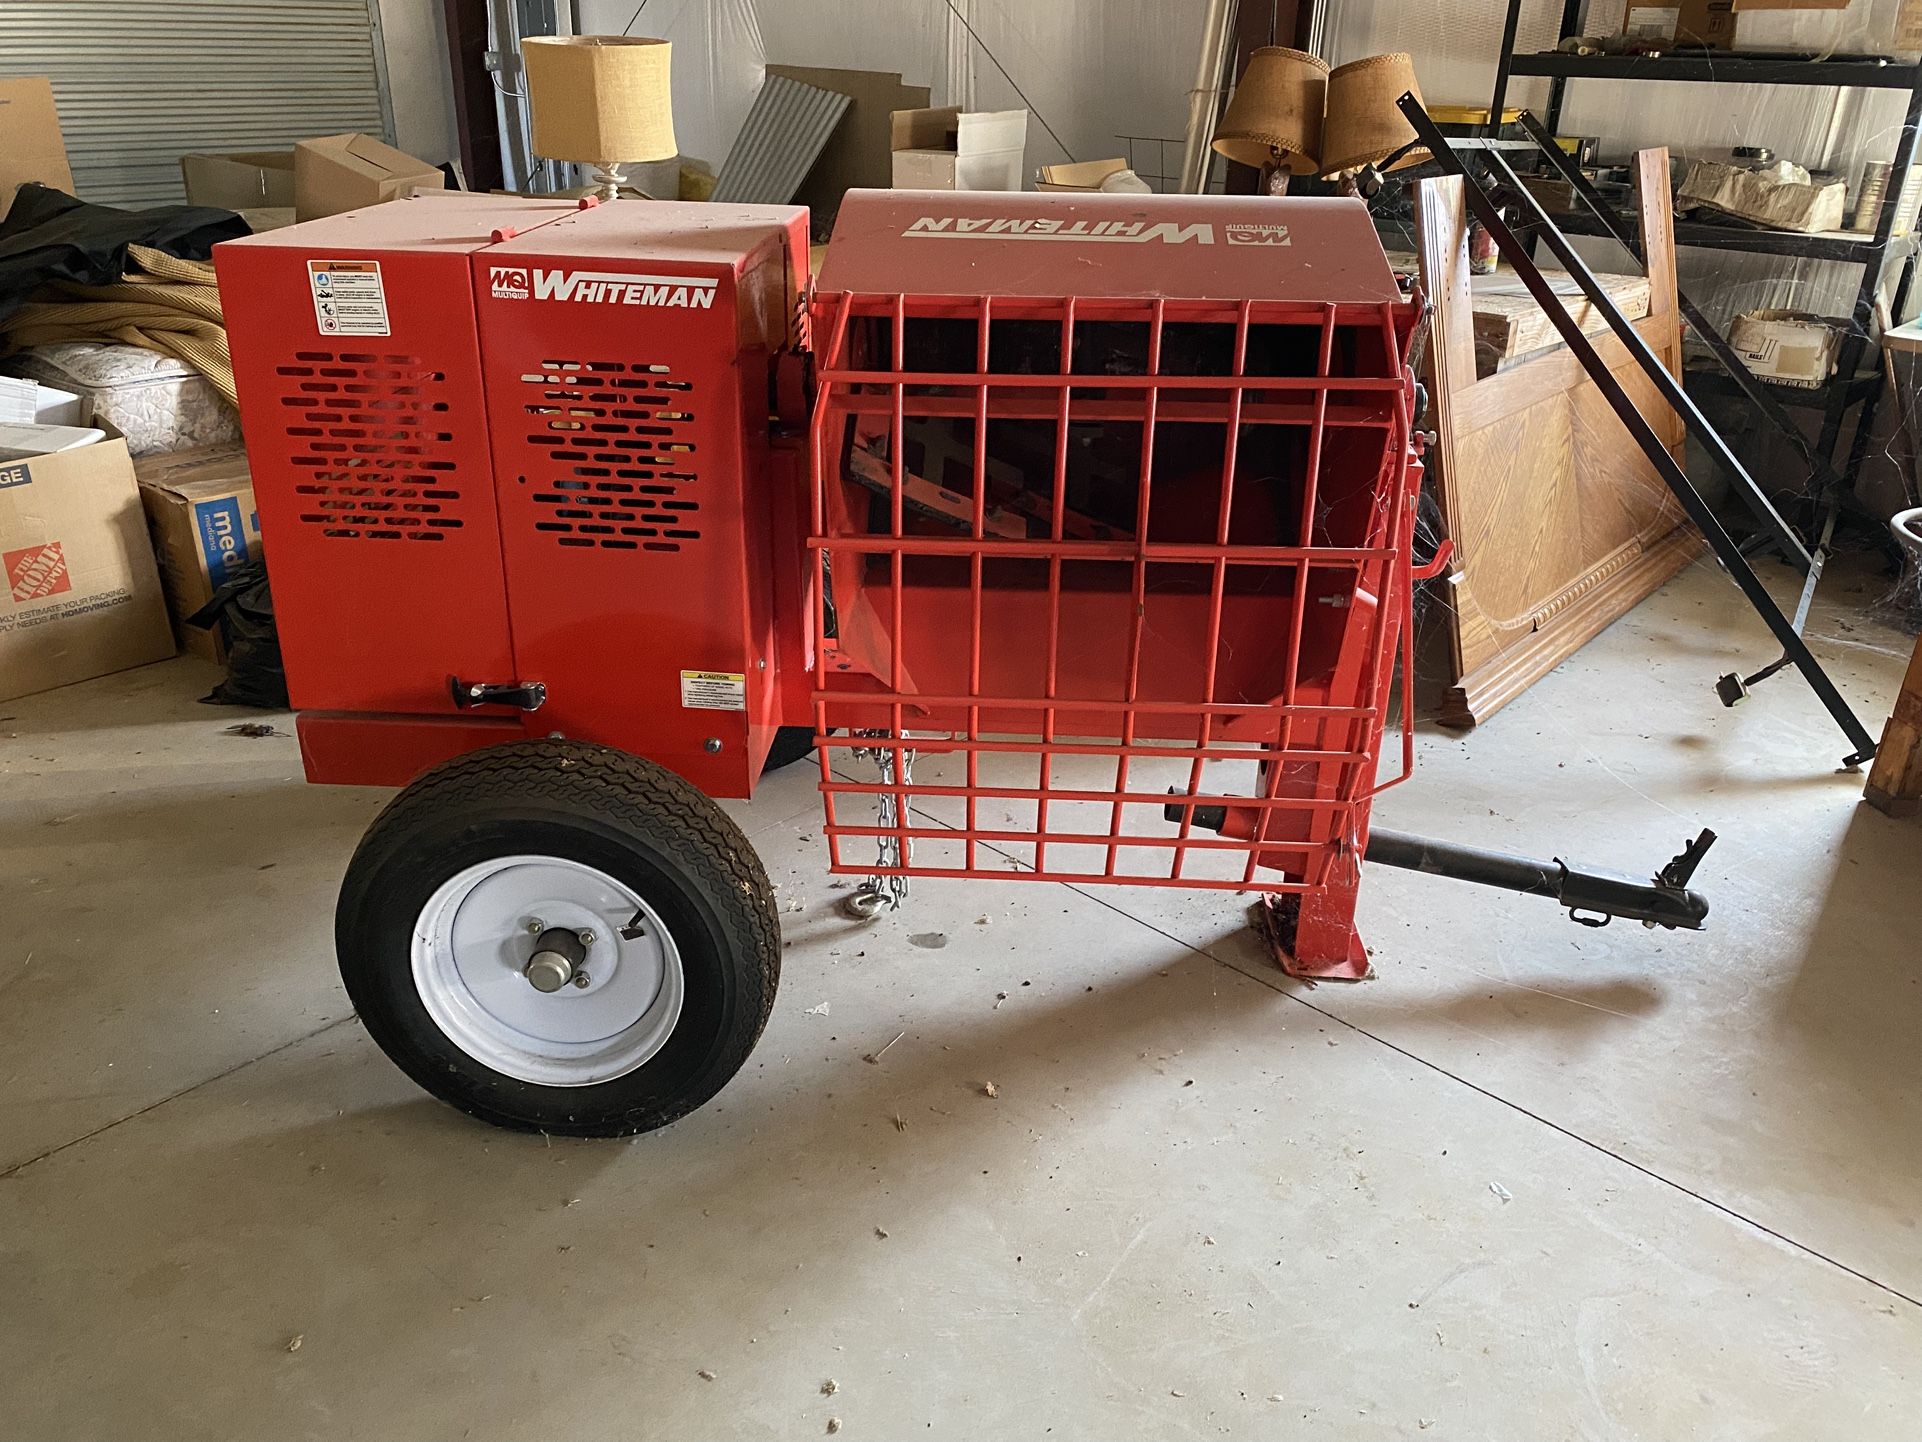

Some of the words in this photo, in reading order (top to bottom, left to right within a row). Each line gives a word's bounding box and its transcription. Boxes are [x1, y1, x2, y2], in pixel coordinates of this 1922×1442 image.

[490, 268, 529, 291] MQ
[533, 269, 719, 309] WHITEMAN
[492, 291, 529, 299] MULTIQUIP
[0, 469, 24, 484] GE
[12, 543, 62, 600] HOME
[13, 553, 36, 577] THE
[36, 560, 66, 596] DEPOT
[17, 615, 47, 629] NEEDS
[49, 612, 61, 621] AT
[19, 603, 61, 620] ESTIMATE
[62, 598, 89, 610] YOUR
